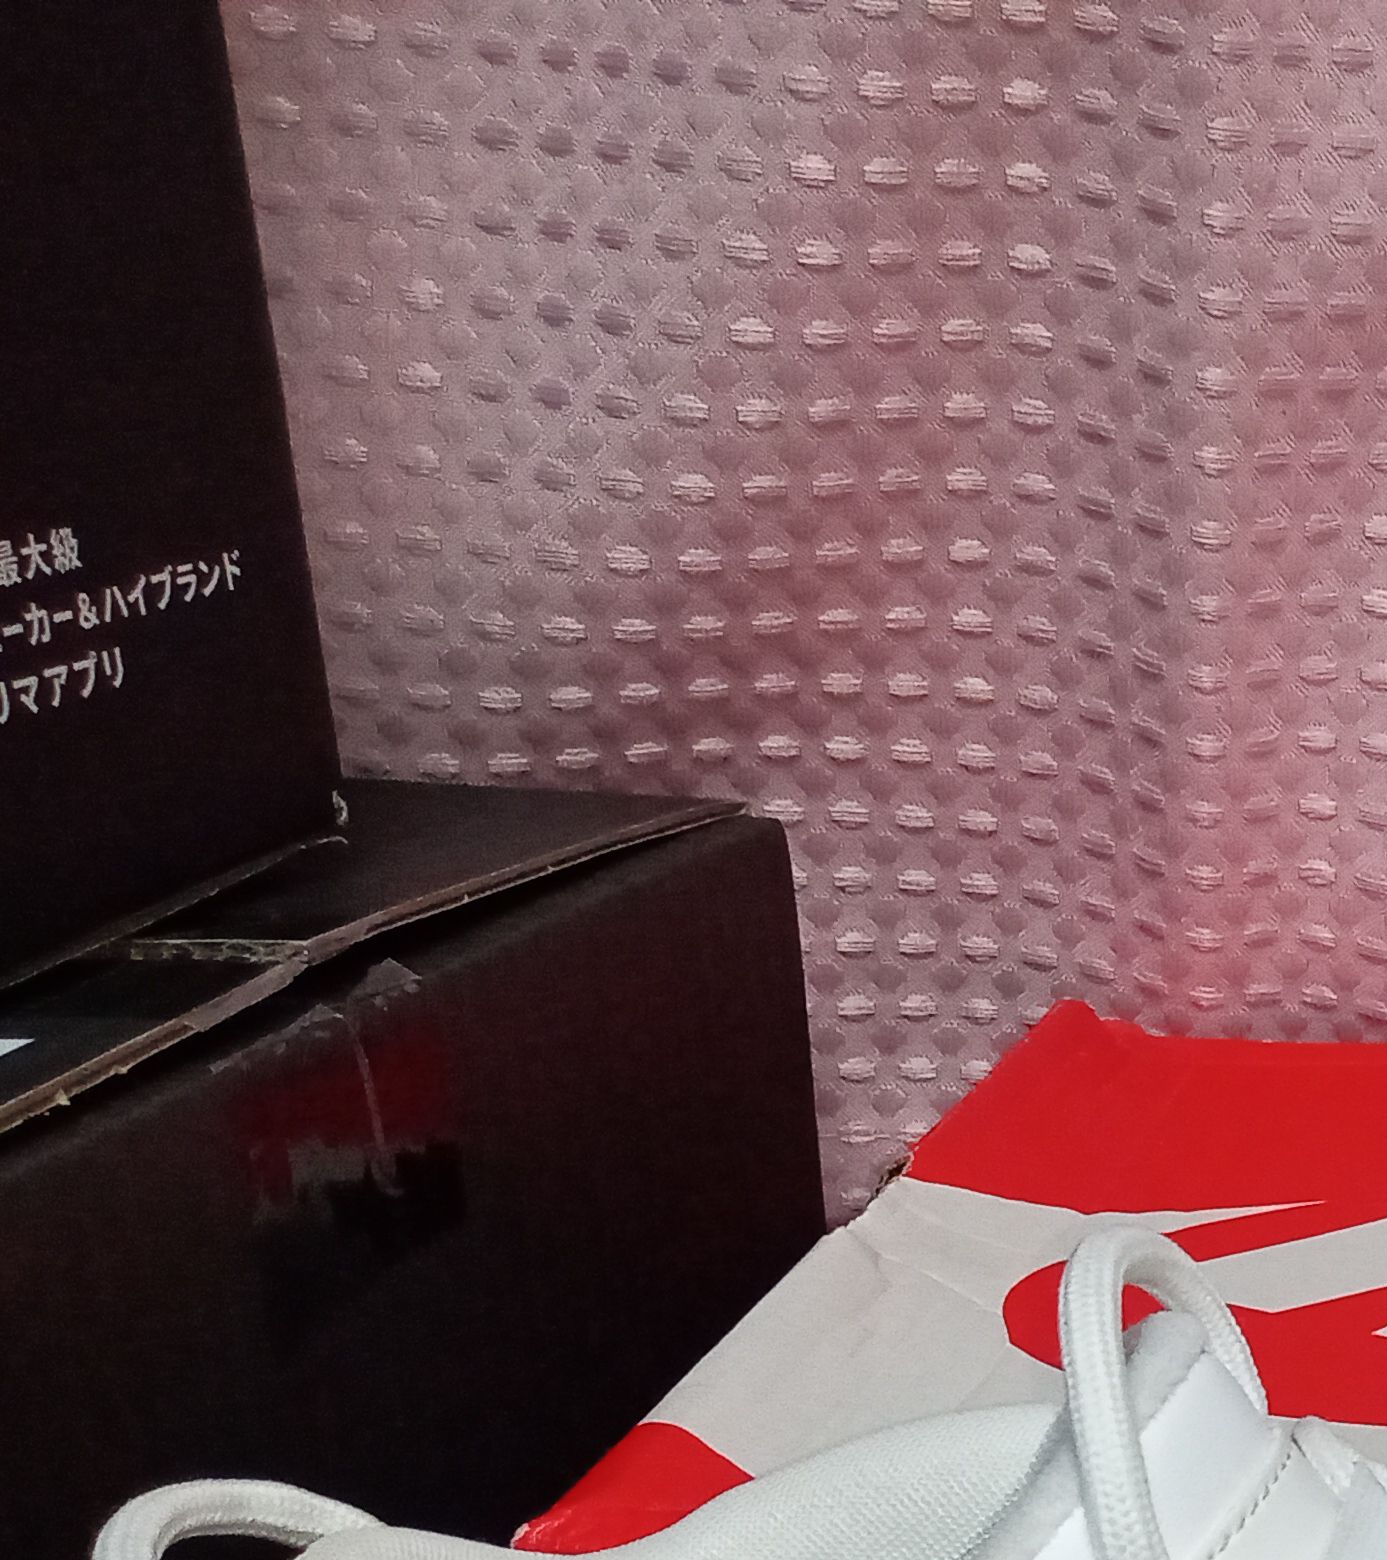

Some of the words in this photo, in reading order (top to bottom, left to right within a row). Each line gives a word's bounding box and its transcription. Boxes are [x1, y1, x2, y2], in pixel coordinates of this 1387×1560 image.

[0, 549, 240, 650] ーカー&ハイブランド
